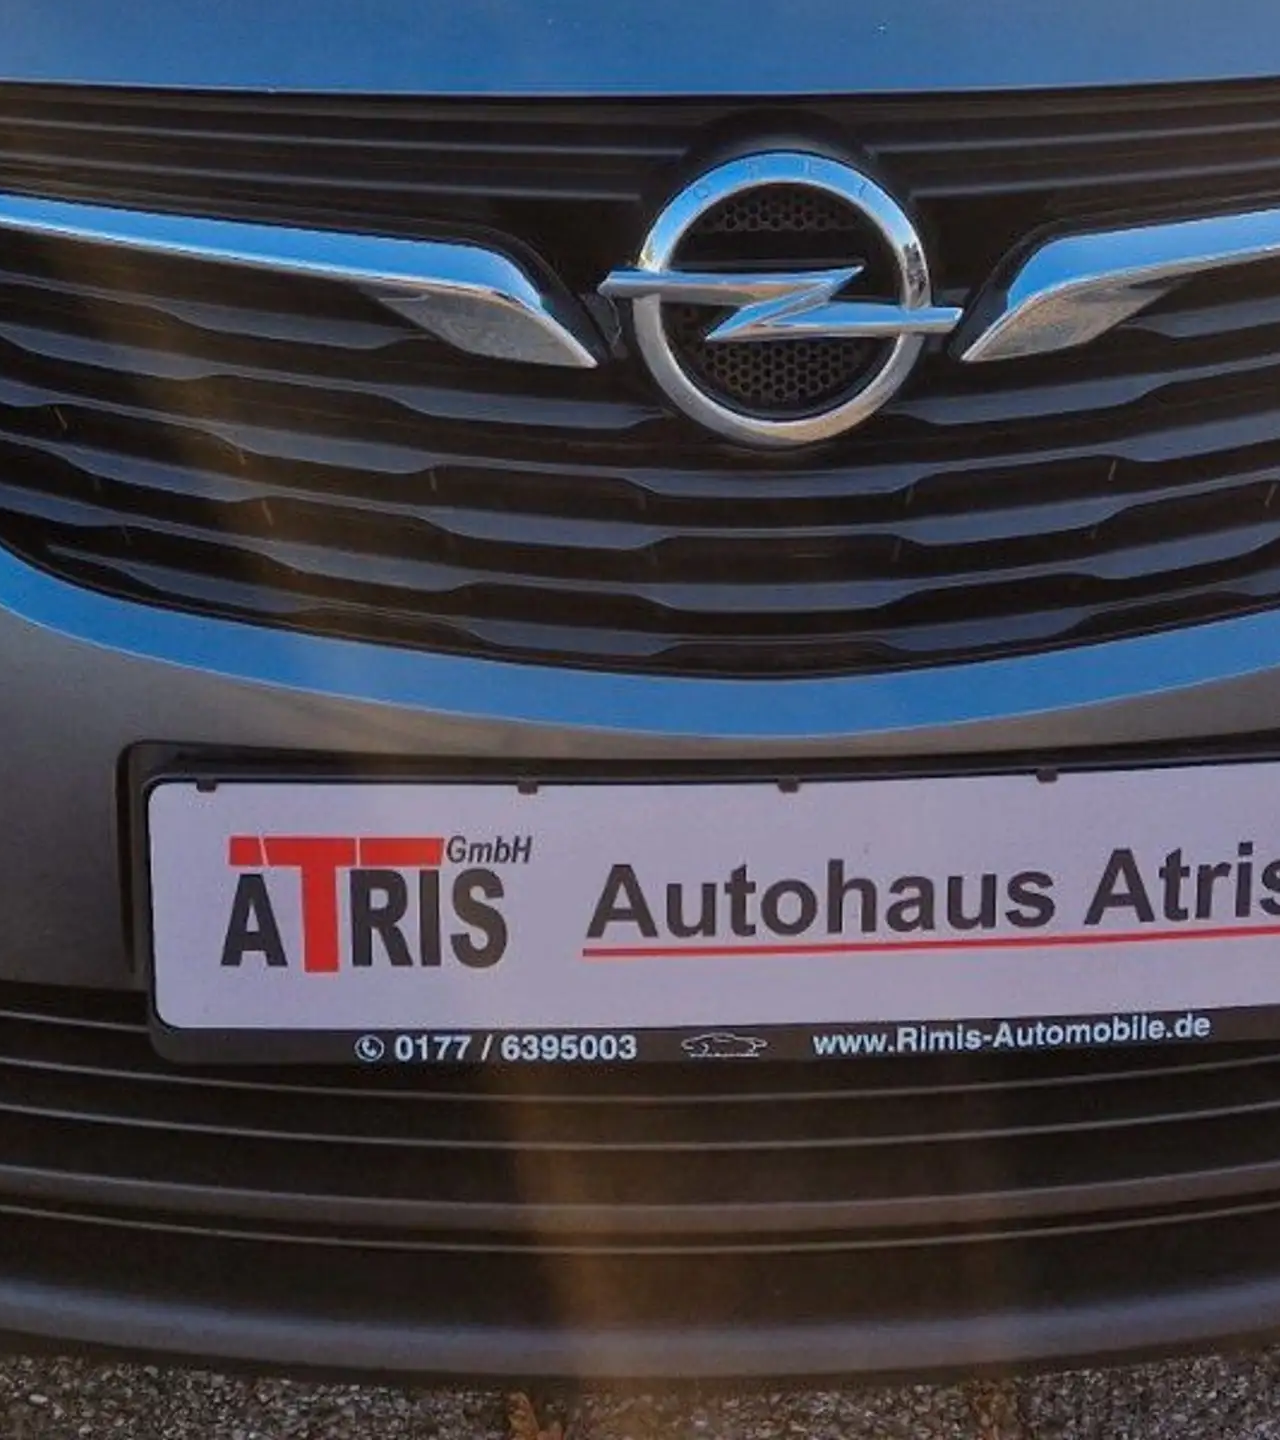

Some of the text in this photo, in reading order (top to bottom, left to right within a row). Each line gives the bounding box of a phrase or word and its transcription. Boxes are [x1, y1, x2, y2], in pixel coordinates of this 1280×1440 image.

[221, 834, 532, 972] ATRIS GmbH
[586, 858, 1056, 939] Autohaus
[394, 1034, 472, 1061] 0177
[500, 1033, 638, 1061] 6395003
[812, 1013, 1212, 1056] www.Rimis-Automobile.de
